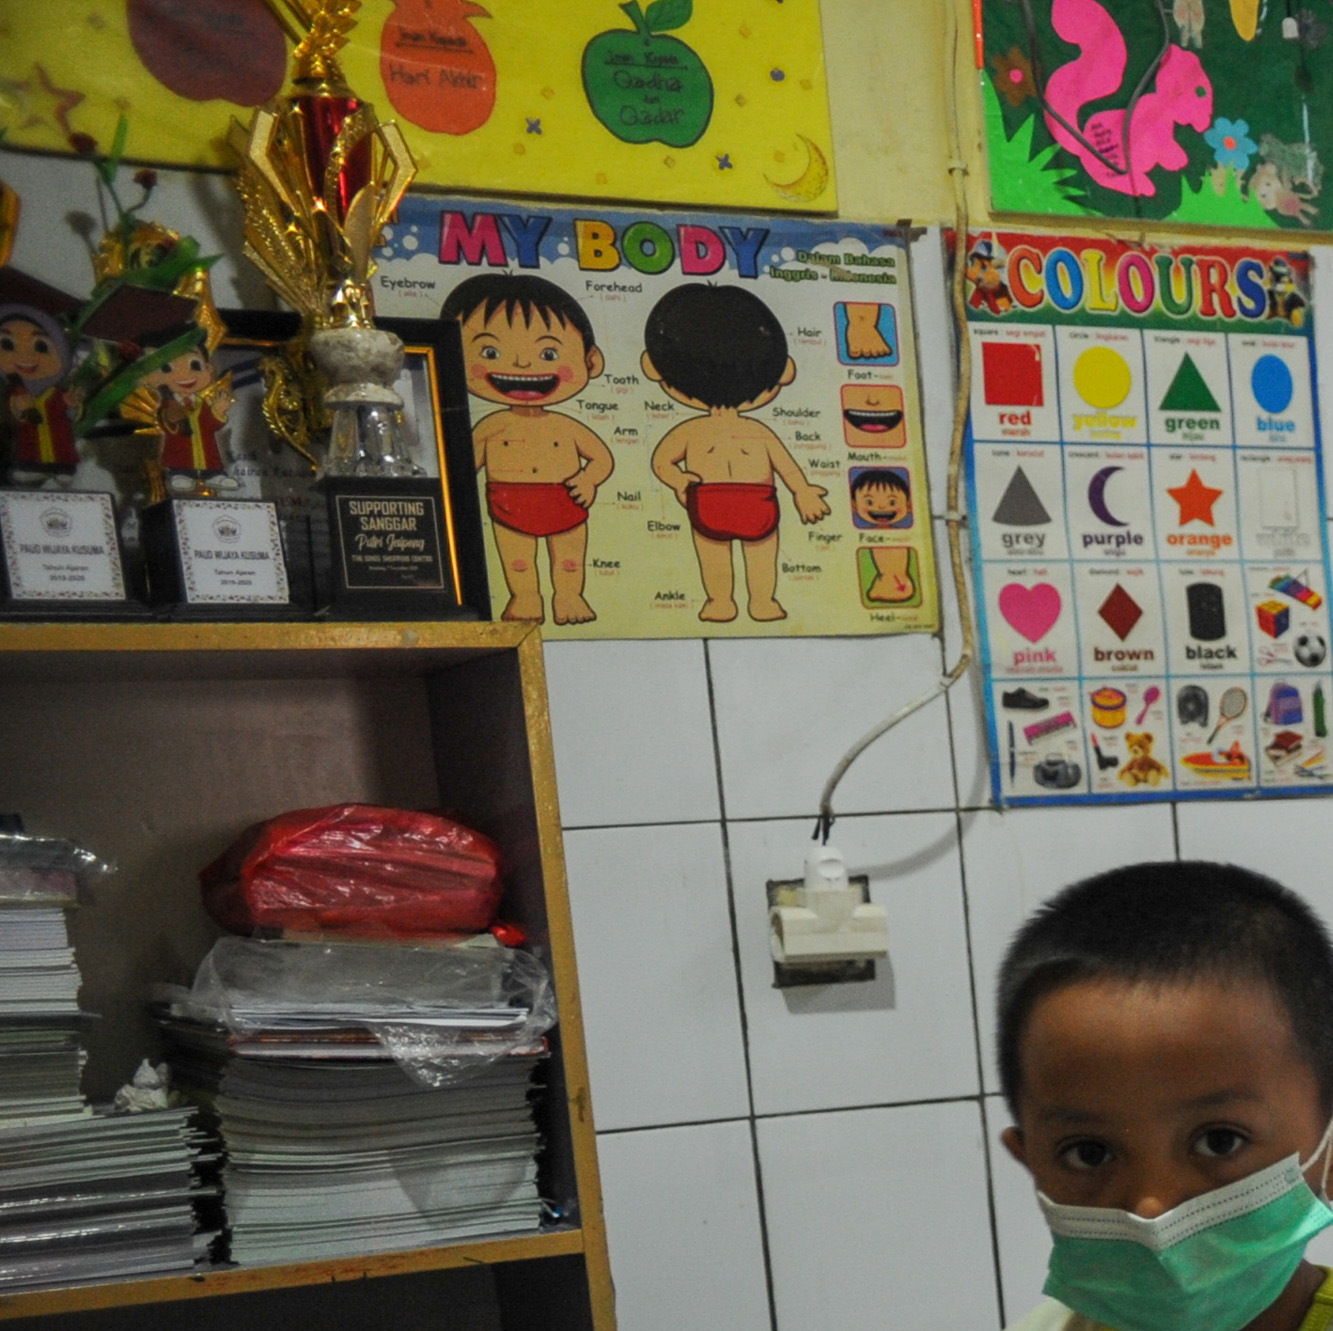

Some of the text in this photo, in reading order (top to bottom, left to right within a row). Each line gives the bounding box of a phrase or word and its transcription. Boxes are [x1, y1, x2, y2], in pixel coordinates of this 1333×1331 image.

[438, 210, 770, 279] MY BODY
[380, 275, 435, 291] Eyebrow
[829, 270, 897, 284] Ionesia
[1005, 245, 1269, 320] COLOURS
[585, 280, 642, 293] Forehead
[798, 327, 822, 338] Hair
[604, 374, 639, 385] Tooth
[576, 400, 619, 413] Tongue
[644, 401, 674, 412] Neck
[772, 407, 821, 418] Shoulder
[998, 411, 1032, 426] red
[1072, 411, 1138, 431] yellow
[1164, 417, 1220, 433] green
[1257, 417, 1295, 432] blue
[613, 426, 638, 436] Arm
[795, 431, 821, 441] Back
[808, 459, 840, 469] Waist
[617, 491, 641, 501] Nail
[349, 501, 424, 516] SUPPORTING
[361, 516, 417, 531] SANGGAR
[647, 521, 681, 532] Elbow
[808, 531, 842, 544] Finger
[1002, 532, 1046, 548] grey
[1082, 530, 1143, 548] purple
[1167, 533, 1233, 549] orange
[215, 551, 240, 560] WIJAYA
[241, 551, 270, 560] KUSUMA
[592, 558, 621, 569] Knee
[782, 563, 821, 573] Bottom
[655, 591, 686, 601] Ankle
[1014, 648, 1056, 665] pink
[1093, 647, 1154, 662] brown
[1185, 645, 1237, 660] black
